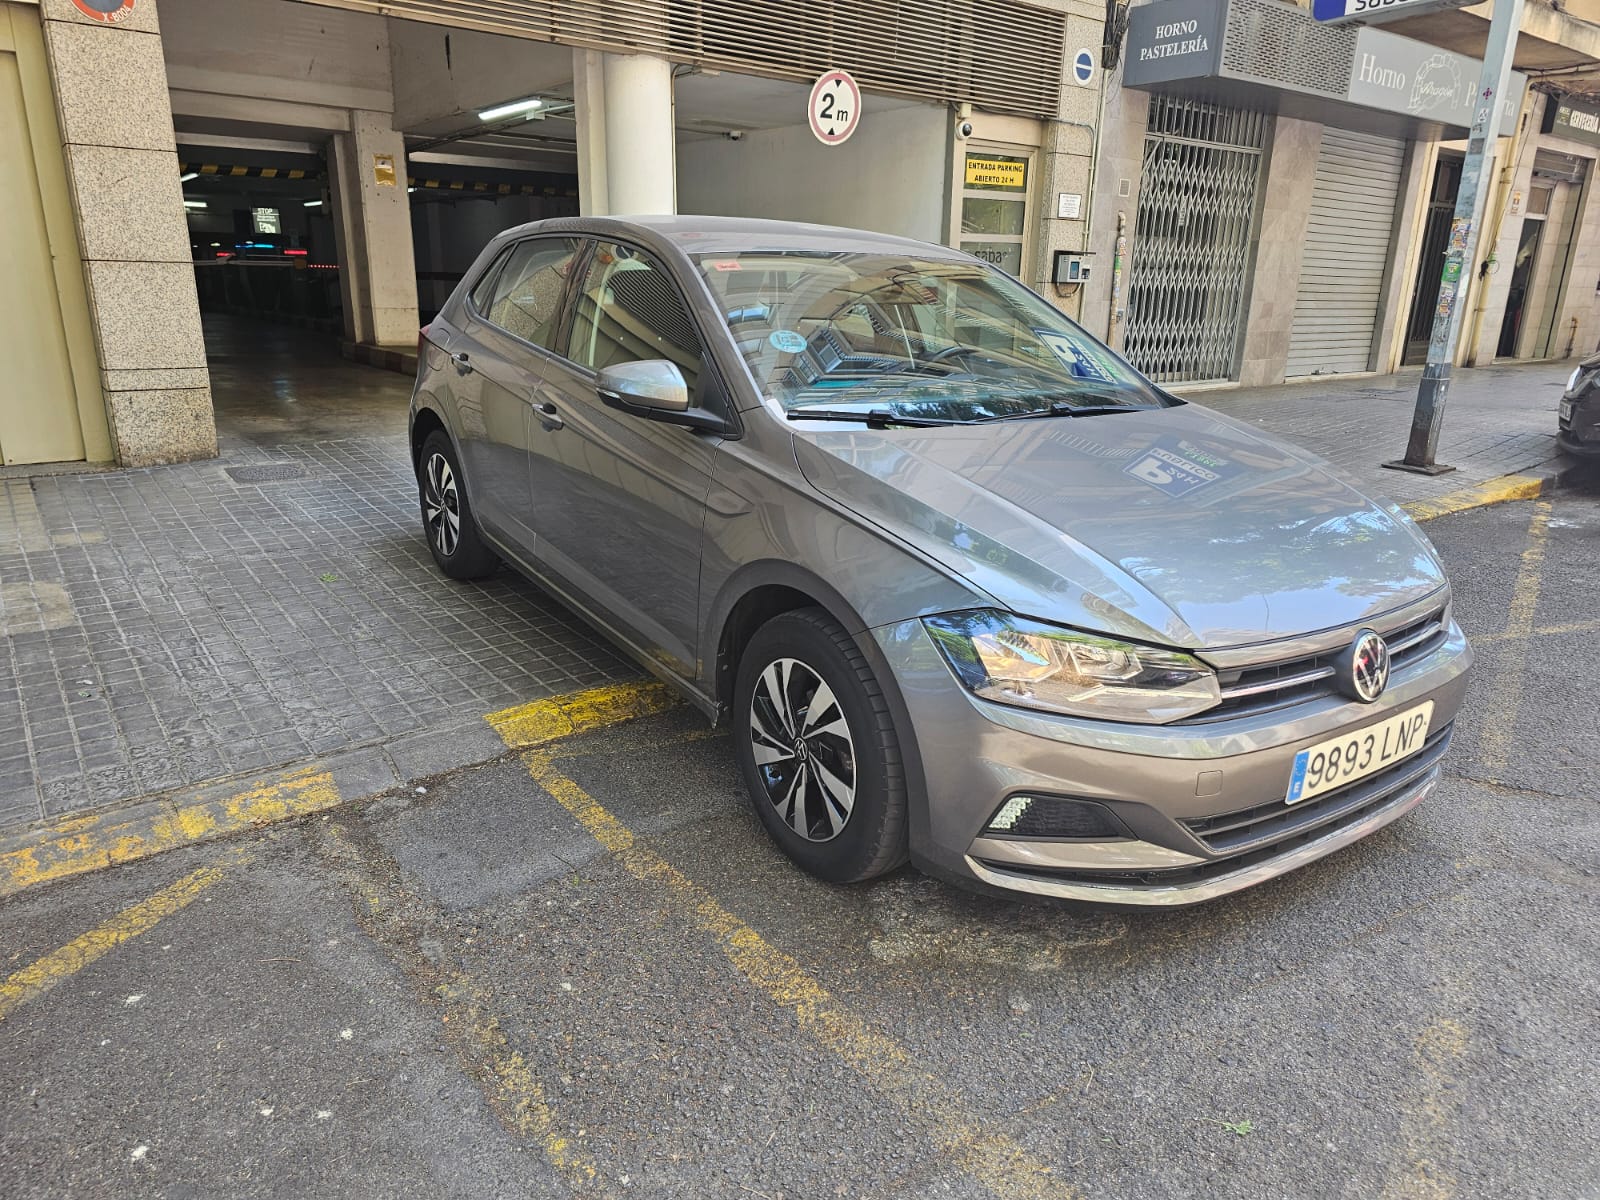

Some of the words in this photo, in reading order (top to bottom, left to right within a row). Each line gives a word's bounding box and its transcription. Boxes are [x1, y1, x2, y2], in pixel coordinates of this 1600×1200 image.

[1155, 20, 1198, 39] HORNO
[1140, 35, 1208, 60] PASTELERÍA
[1358, 53, 1406, 90] Horno
[820, 93, 835, 119] 2
[837, 109, 849, 122] m
[968, 161, 996, 171] ENTRADA
[997, 164, 1023, 173] PARKING
[974, 174, 999, 183] ABIERTO
[974, 246, 1002, 263] saba
[1308, 734, 1375, 789] 9893
[1380, 713, 1424, 761] LNP
